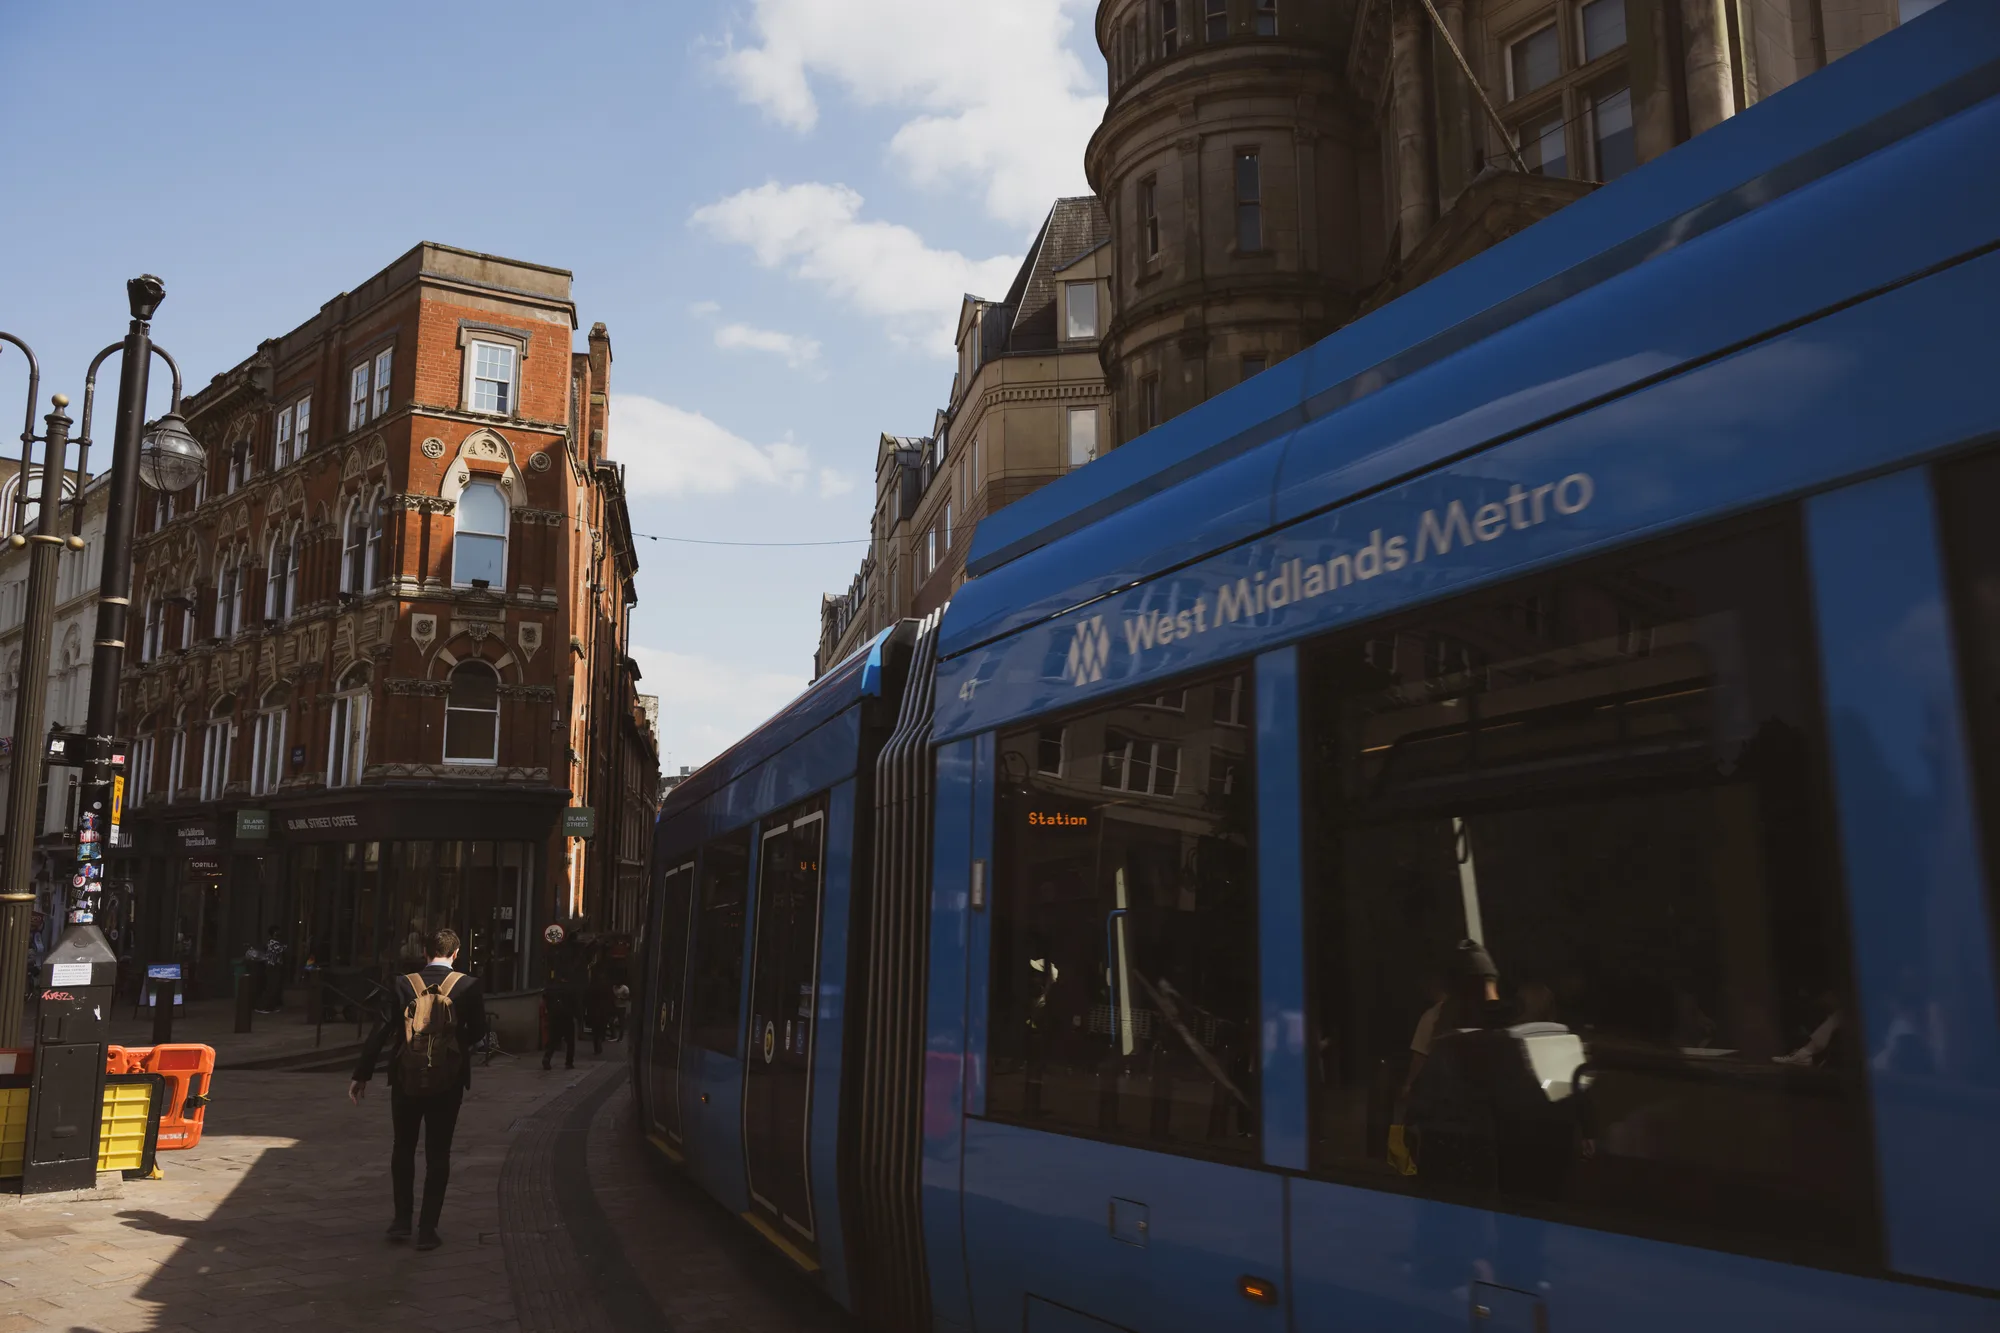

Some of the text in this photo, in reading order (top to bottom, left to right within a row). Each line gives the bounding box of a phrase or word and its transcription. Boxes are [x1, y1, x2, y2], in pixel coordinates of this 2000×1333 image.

[1124, 472, 1595, 655] West Midlands Metro
[287, 815, 358, 830] BLANK STREET COFFEE
[1028, 811, 1087, 825] Station
